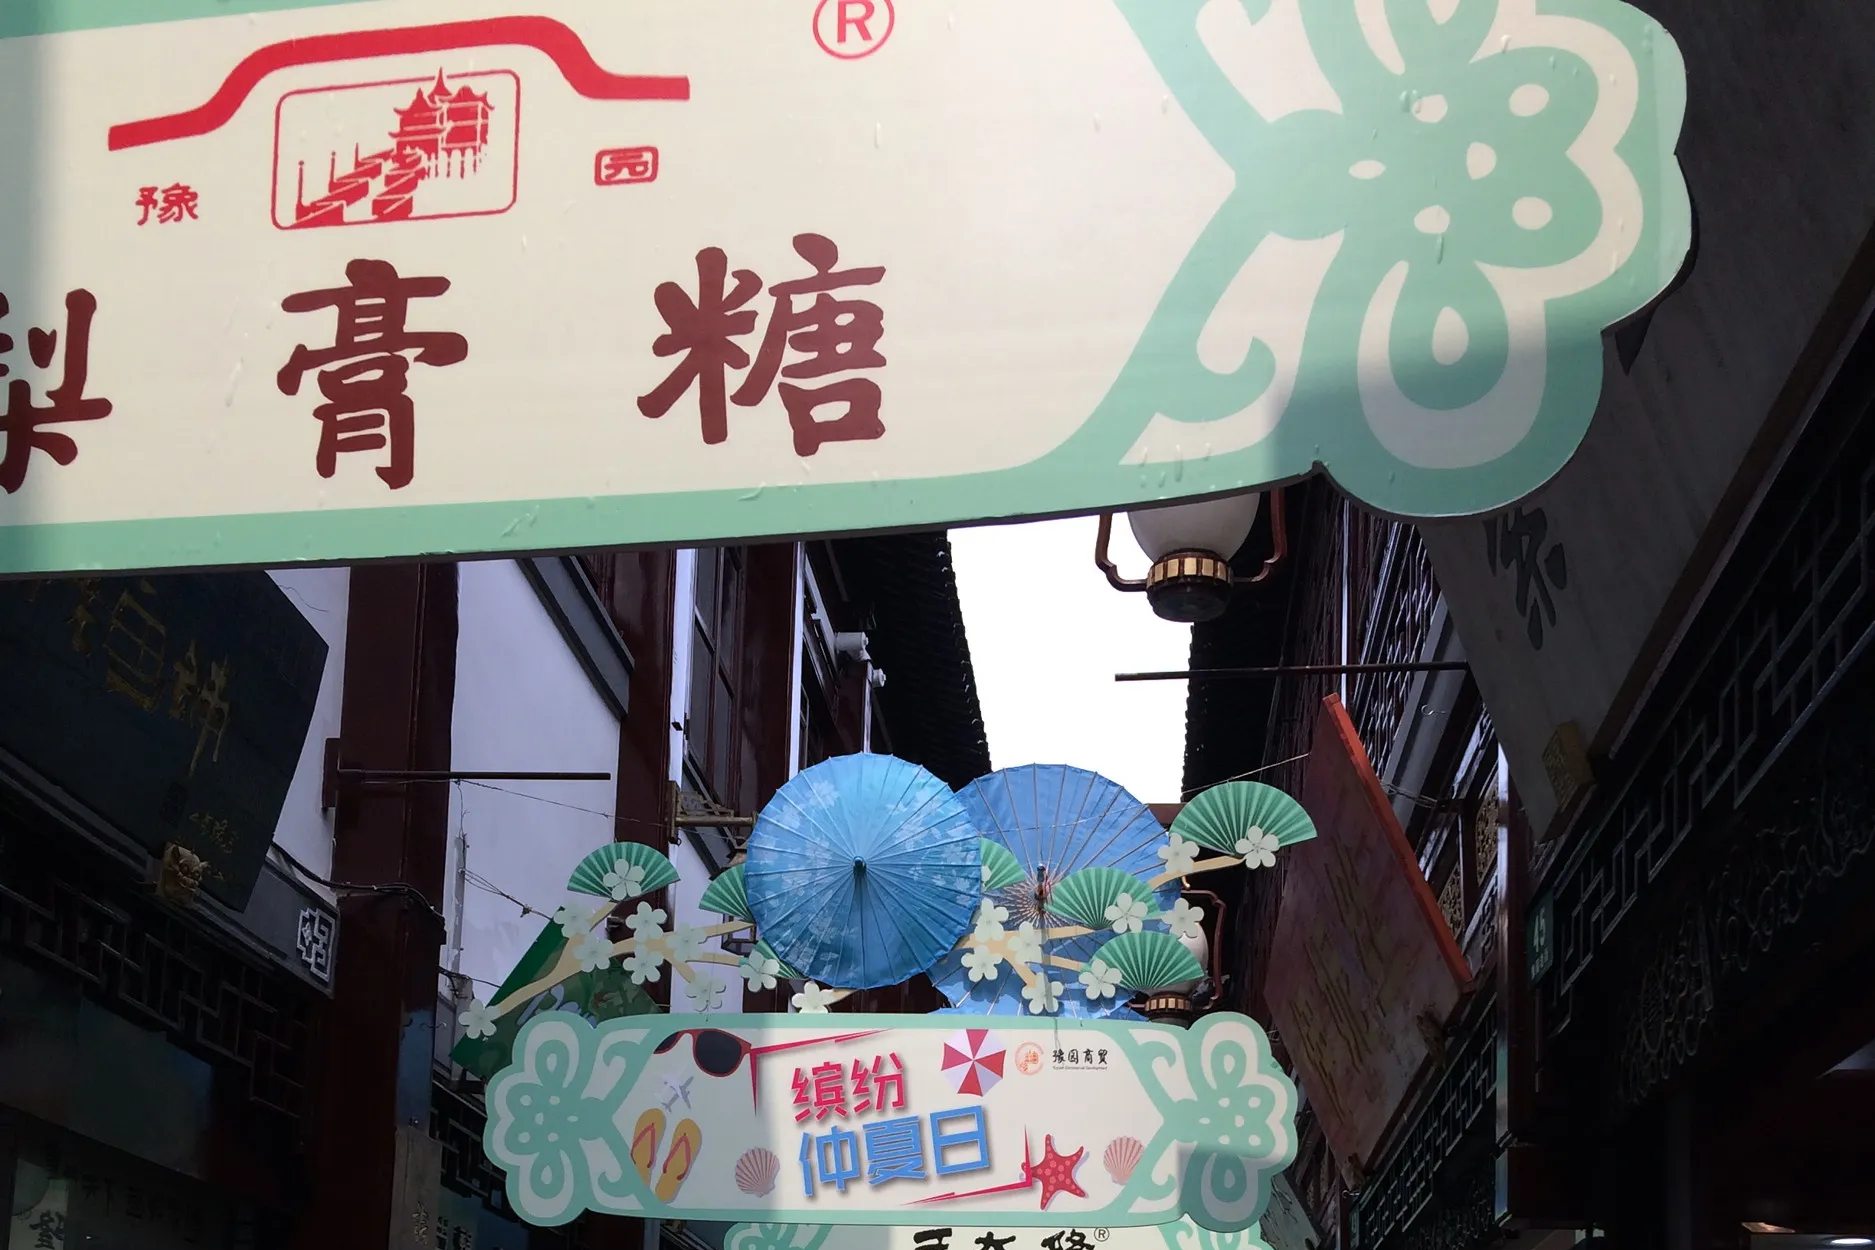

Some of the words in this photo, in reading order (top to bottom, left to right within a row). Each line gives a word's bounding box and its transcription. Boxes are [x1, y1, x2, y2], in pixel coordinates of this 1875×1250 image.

[792, 1052, 906, 1122] 缤纷
[799, 1105, 991, 1198] 仲夏日
